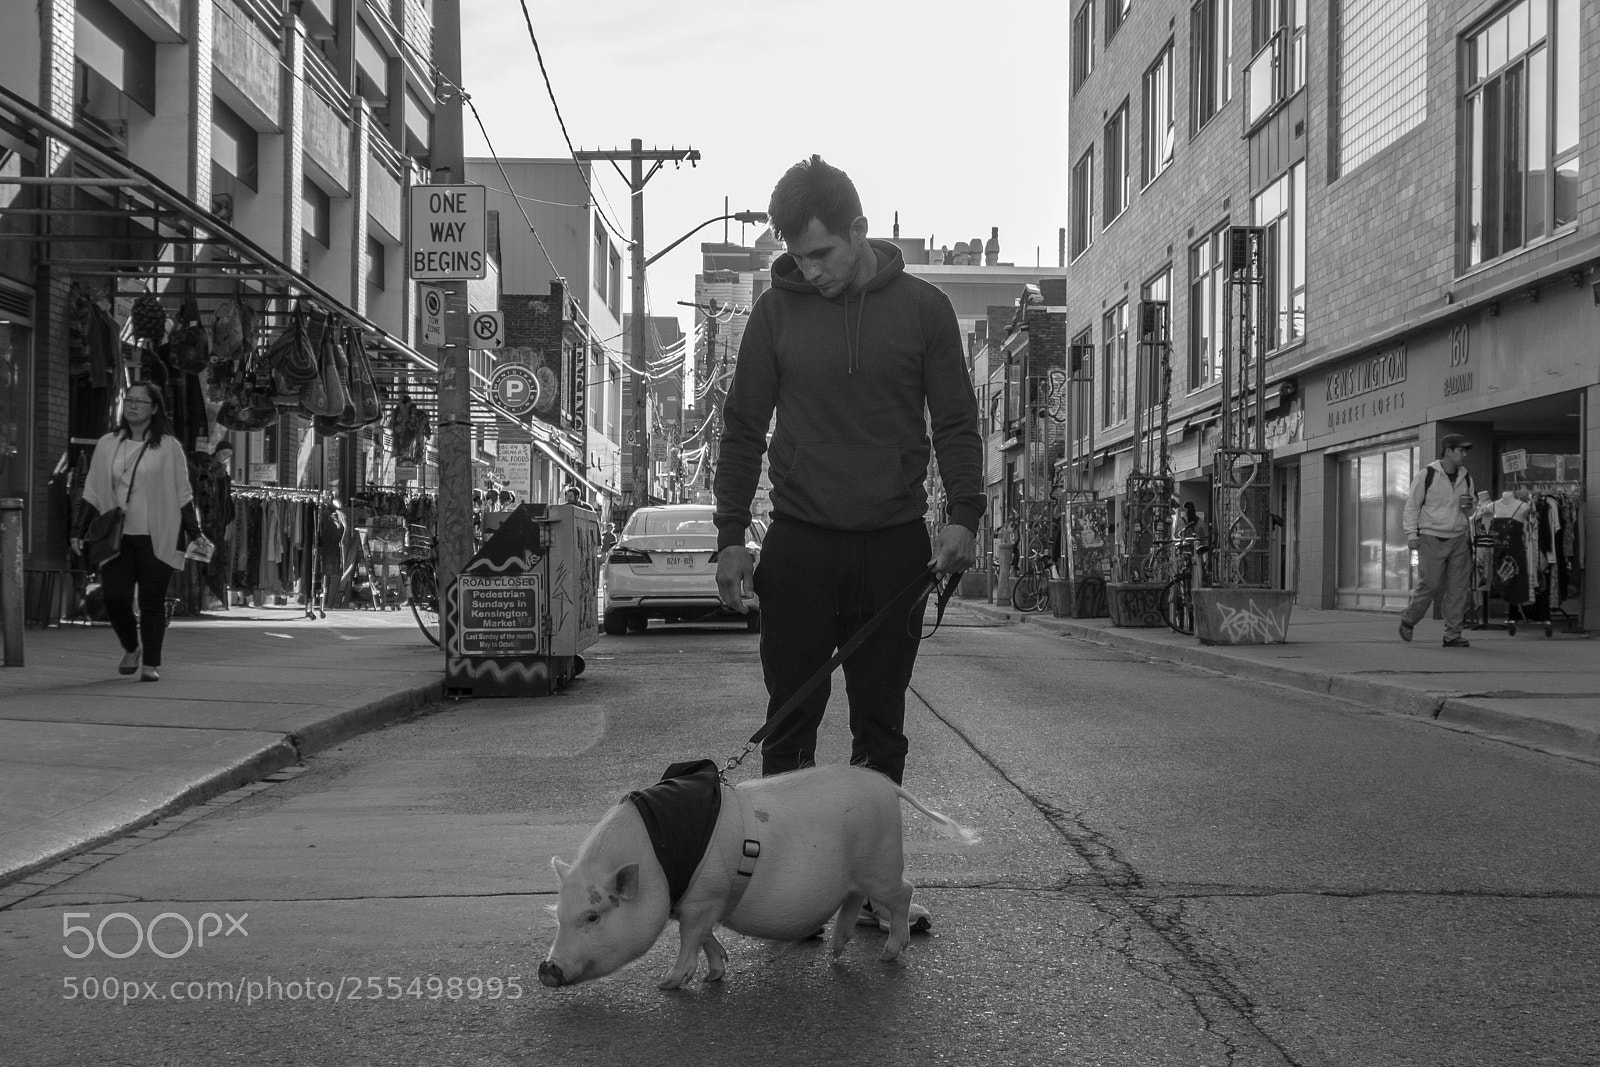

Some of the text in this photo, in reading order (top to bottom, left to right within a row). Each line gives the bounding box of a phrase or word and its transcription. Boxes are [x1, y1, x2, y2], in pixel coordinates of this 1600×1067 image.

[429, 192, 467, 213] ONE
[429, 222, 466, 242] WAY
[414, 251, 481, 271] BEGINS
[428, 316, 438, 325] TOW
[427, 324, 440, 334] ZONE
[1449, 323, 1469, 368] 160
[1326, 347, 1406, 402] KENSINGTON
[506, 380, 523, 397] P
[1444, 372, 1472, 397] BALDWIN
[1328, 402, 1365, 428] MARKET
[1373, 391, 1404, 416] LOFTS
[463, 578, 535, 587] ROAD CLOSED
[473, 590, 525, 598] Pedestrian
[472, 600, 514, 609] Sundays
[471, 610, 528, 619] Kensington
[483, 619, 516, 627] Market
[479, 633, 499, 641] Sunday
